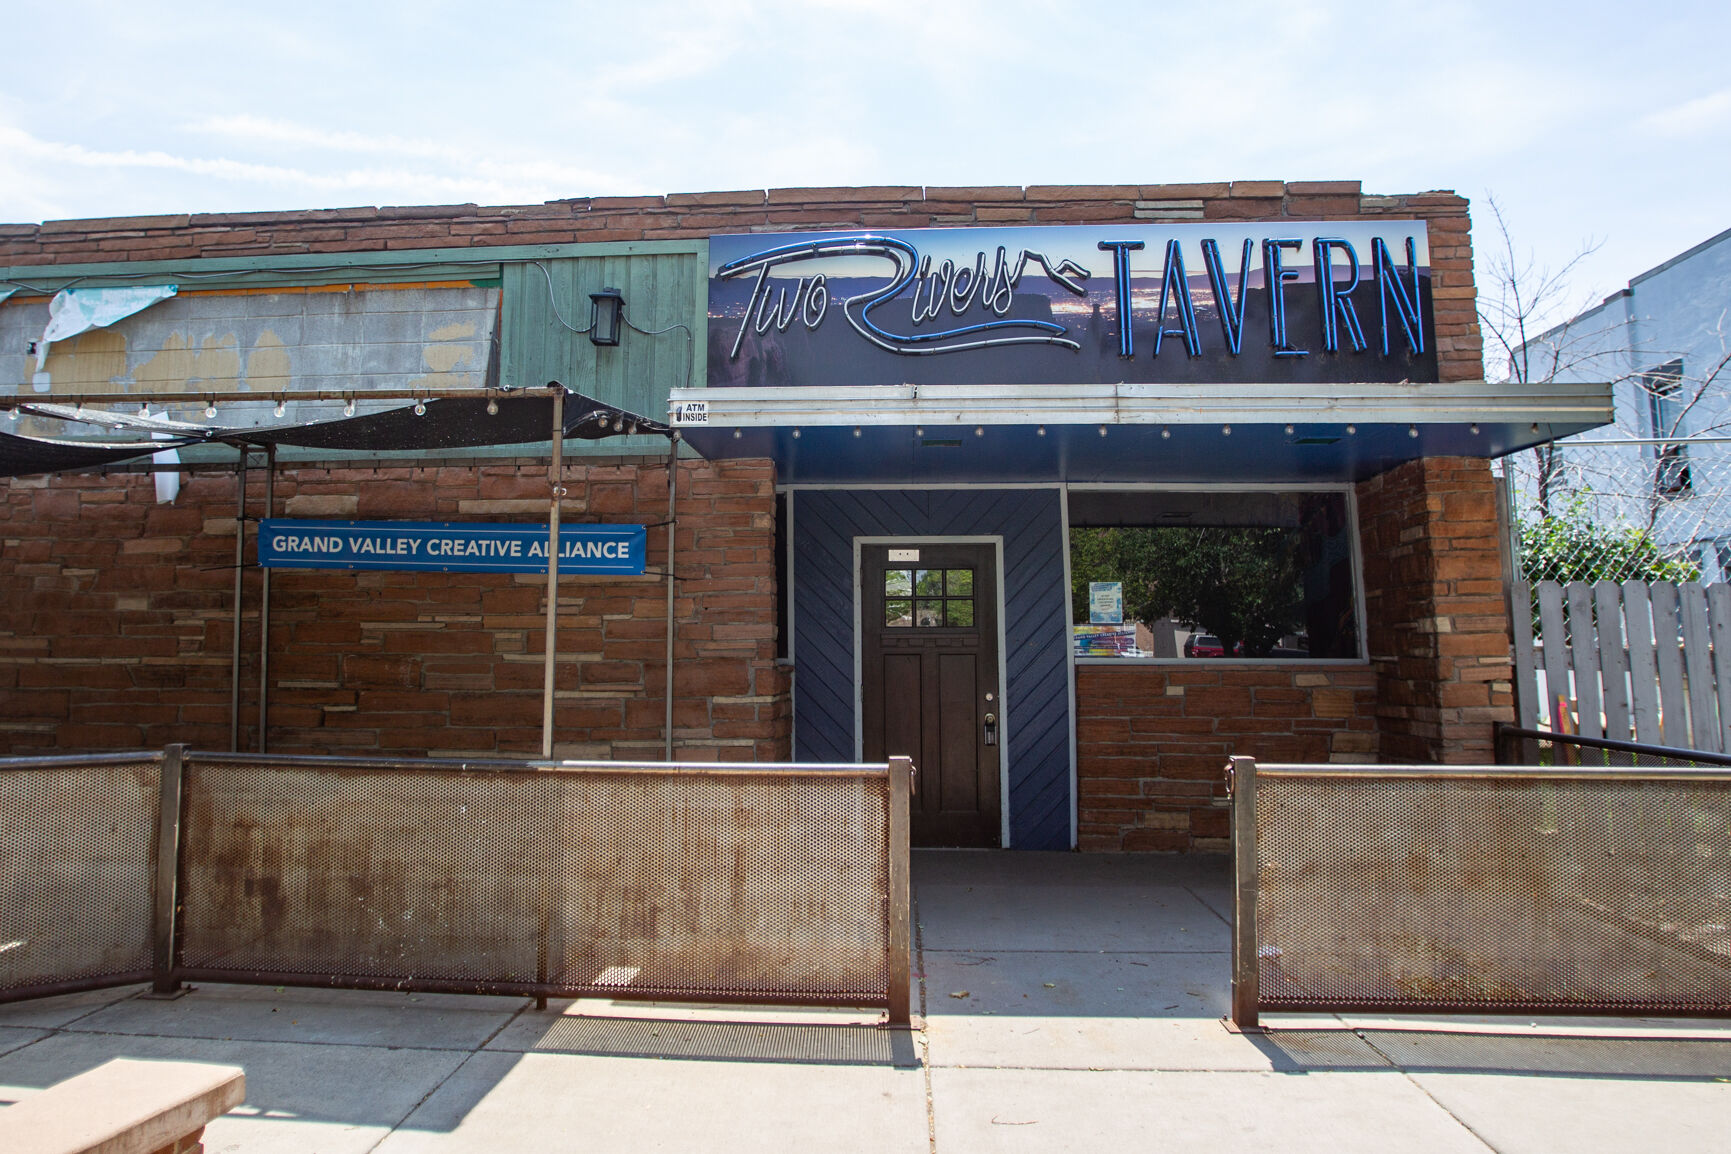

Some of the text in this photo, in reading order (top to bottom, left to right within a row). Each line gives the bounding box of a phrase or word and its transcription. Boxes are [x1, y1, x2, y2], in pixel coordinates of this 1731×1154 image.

[718, 234, 1425, 361] Two Rivers TAVERN
[686, 403, 705, 412] ATM
[682, 412, 708, 422] INSIDE
[272, 535, 343, 553] GRAND
[349, 537, 422, 555] VALLEY
[426, 538, 522, 557] CREATIVE
